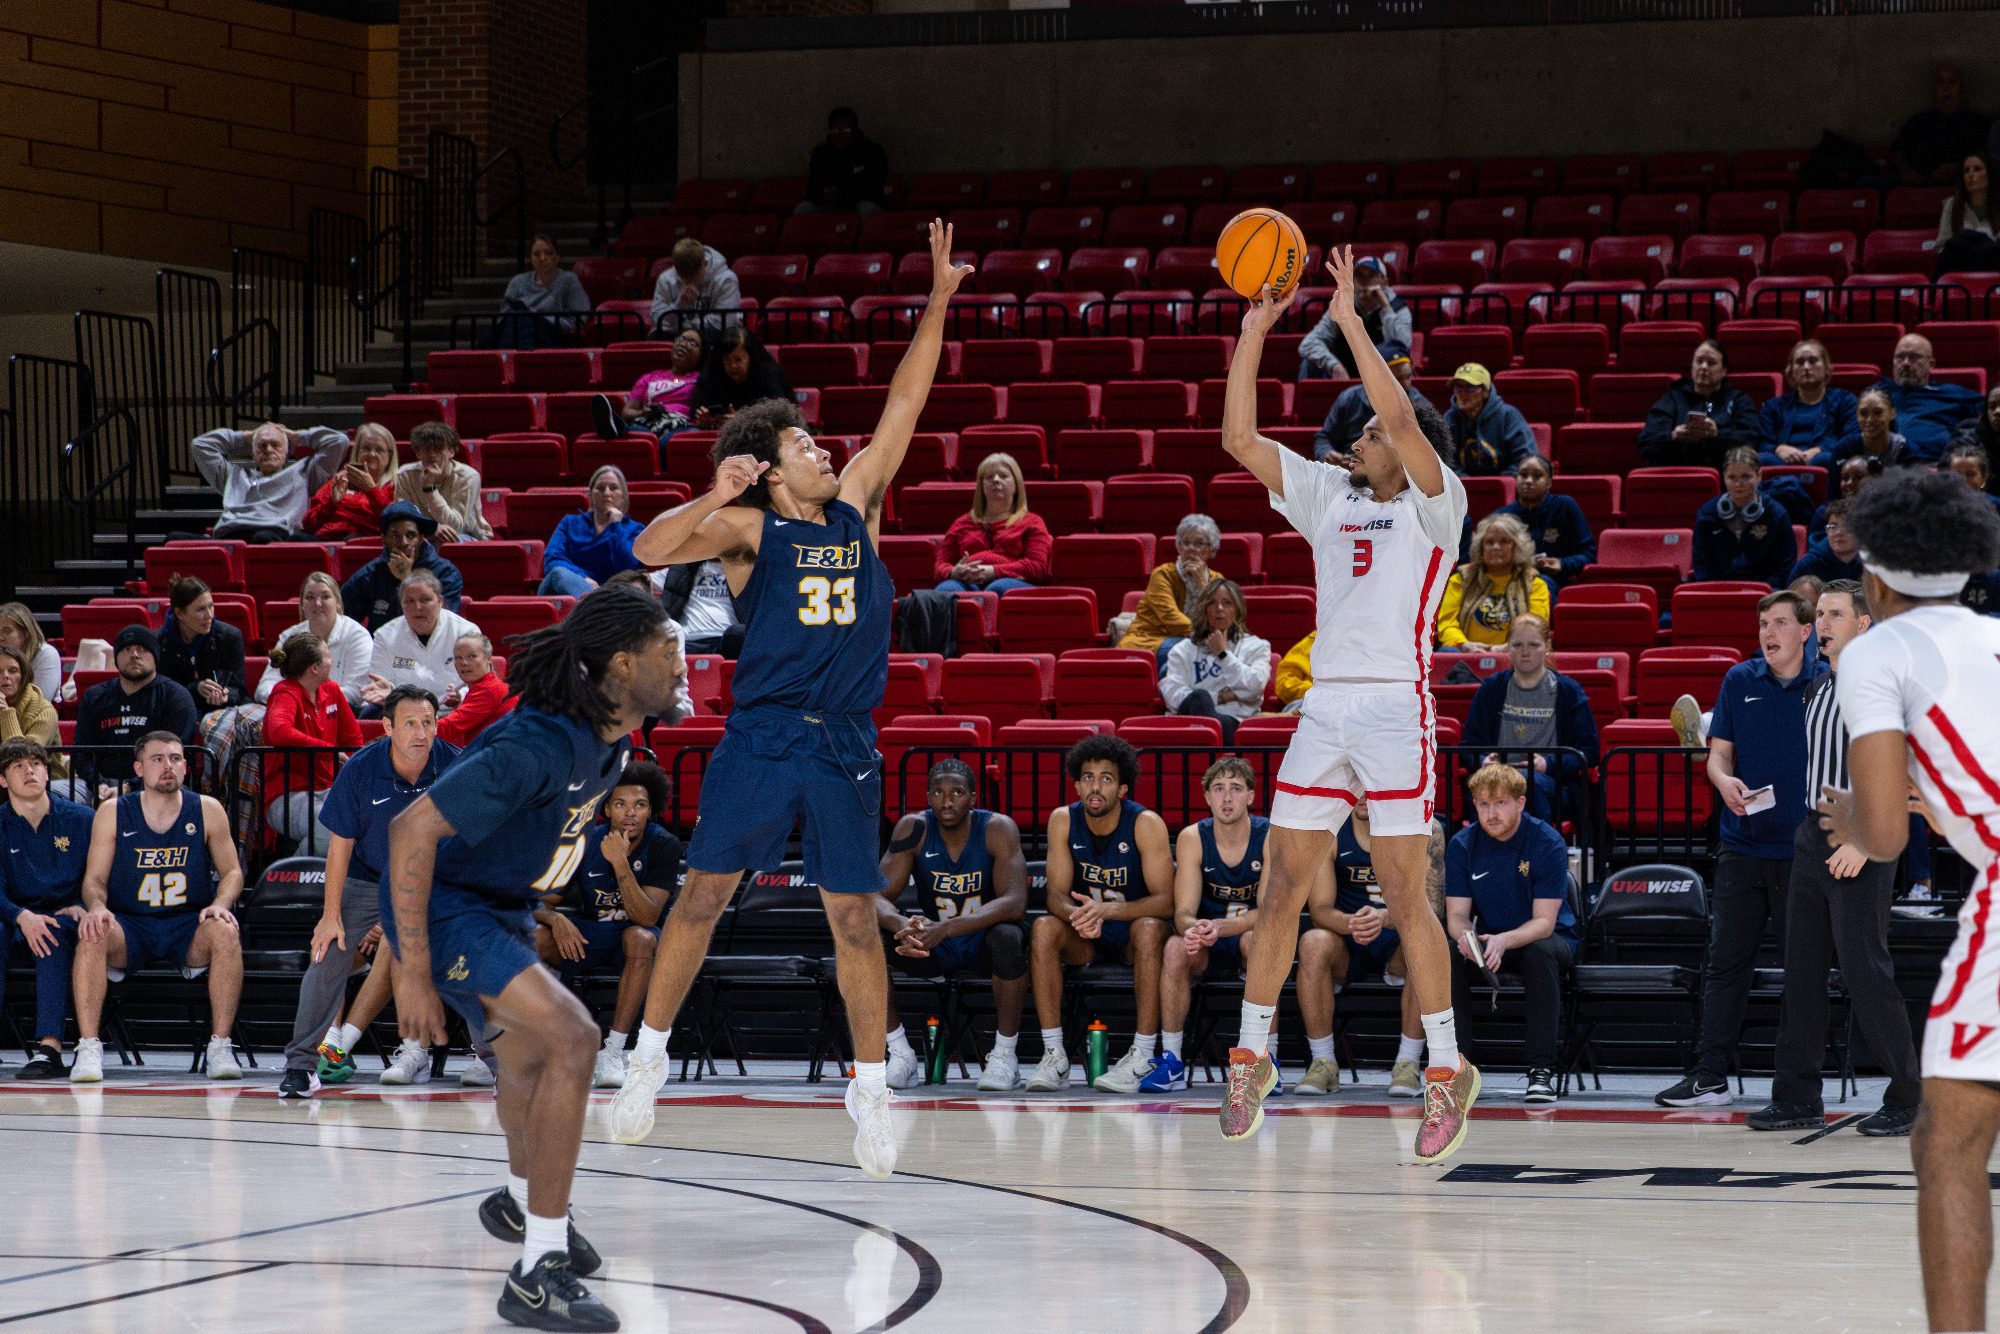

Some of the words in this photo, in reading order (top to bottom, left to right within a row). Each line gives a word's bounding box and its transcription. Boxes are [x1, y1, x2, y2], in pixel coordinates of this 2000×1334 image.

[791, 540, 860, 569] E&H
[1353, 539, 1373, 577] 3
[798, 576, 857, 625] 33
[133, 846, 189, 868] E&H
[531, 834, 585, 891] 10
[266, 871, 326, 884] UVAWIS
[930, 870, 982, 895] E&H
[1079, 861, 1128, 888] E&H
[1612, 880, 1694, 894] UVAWISE
[137, 872, 187, 907] 42
[1950, 1022, 1997, 1061] V
